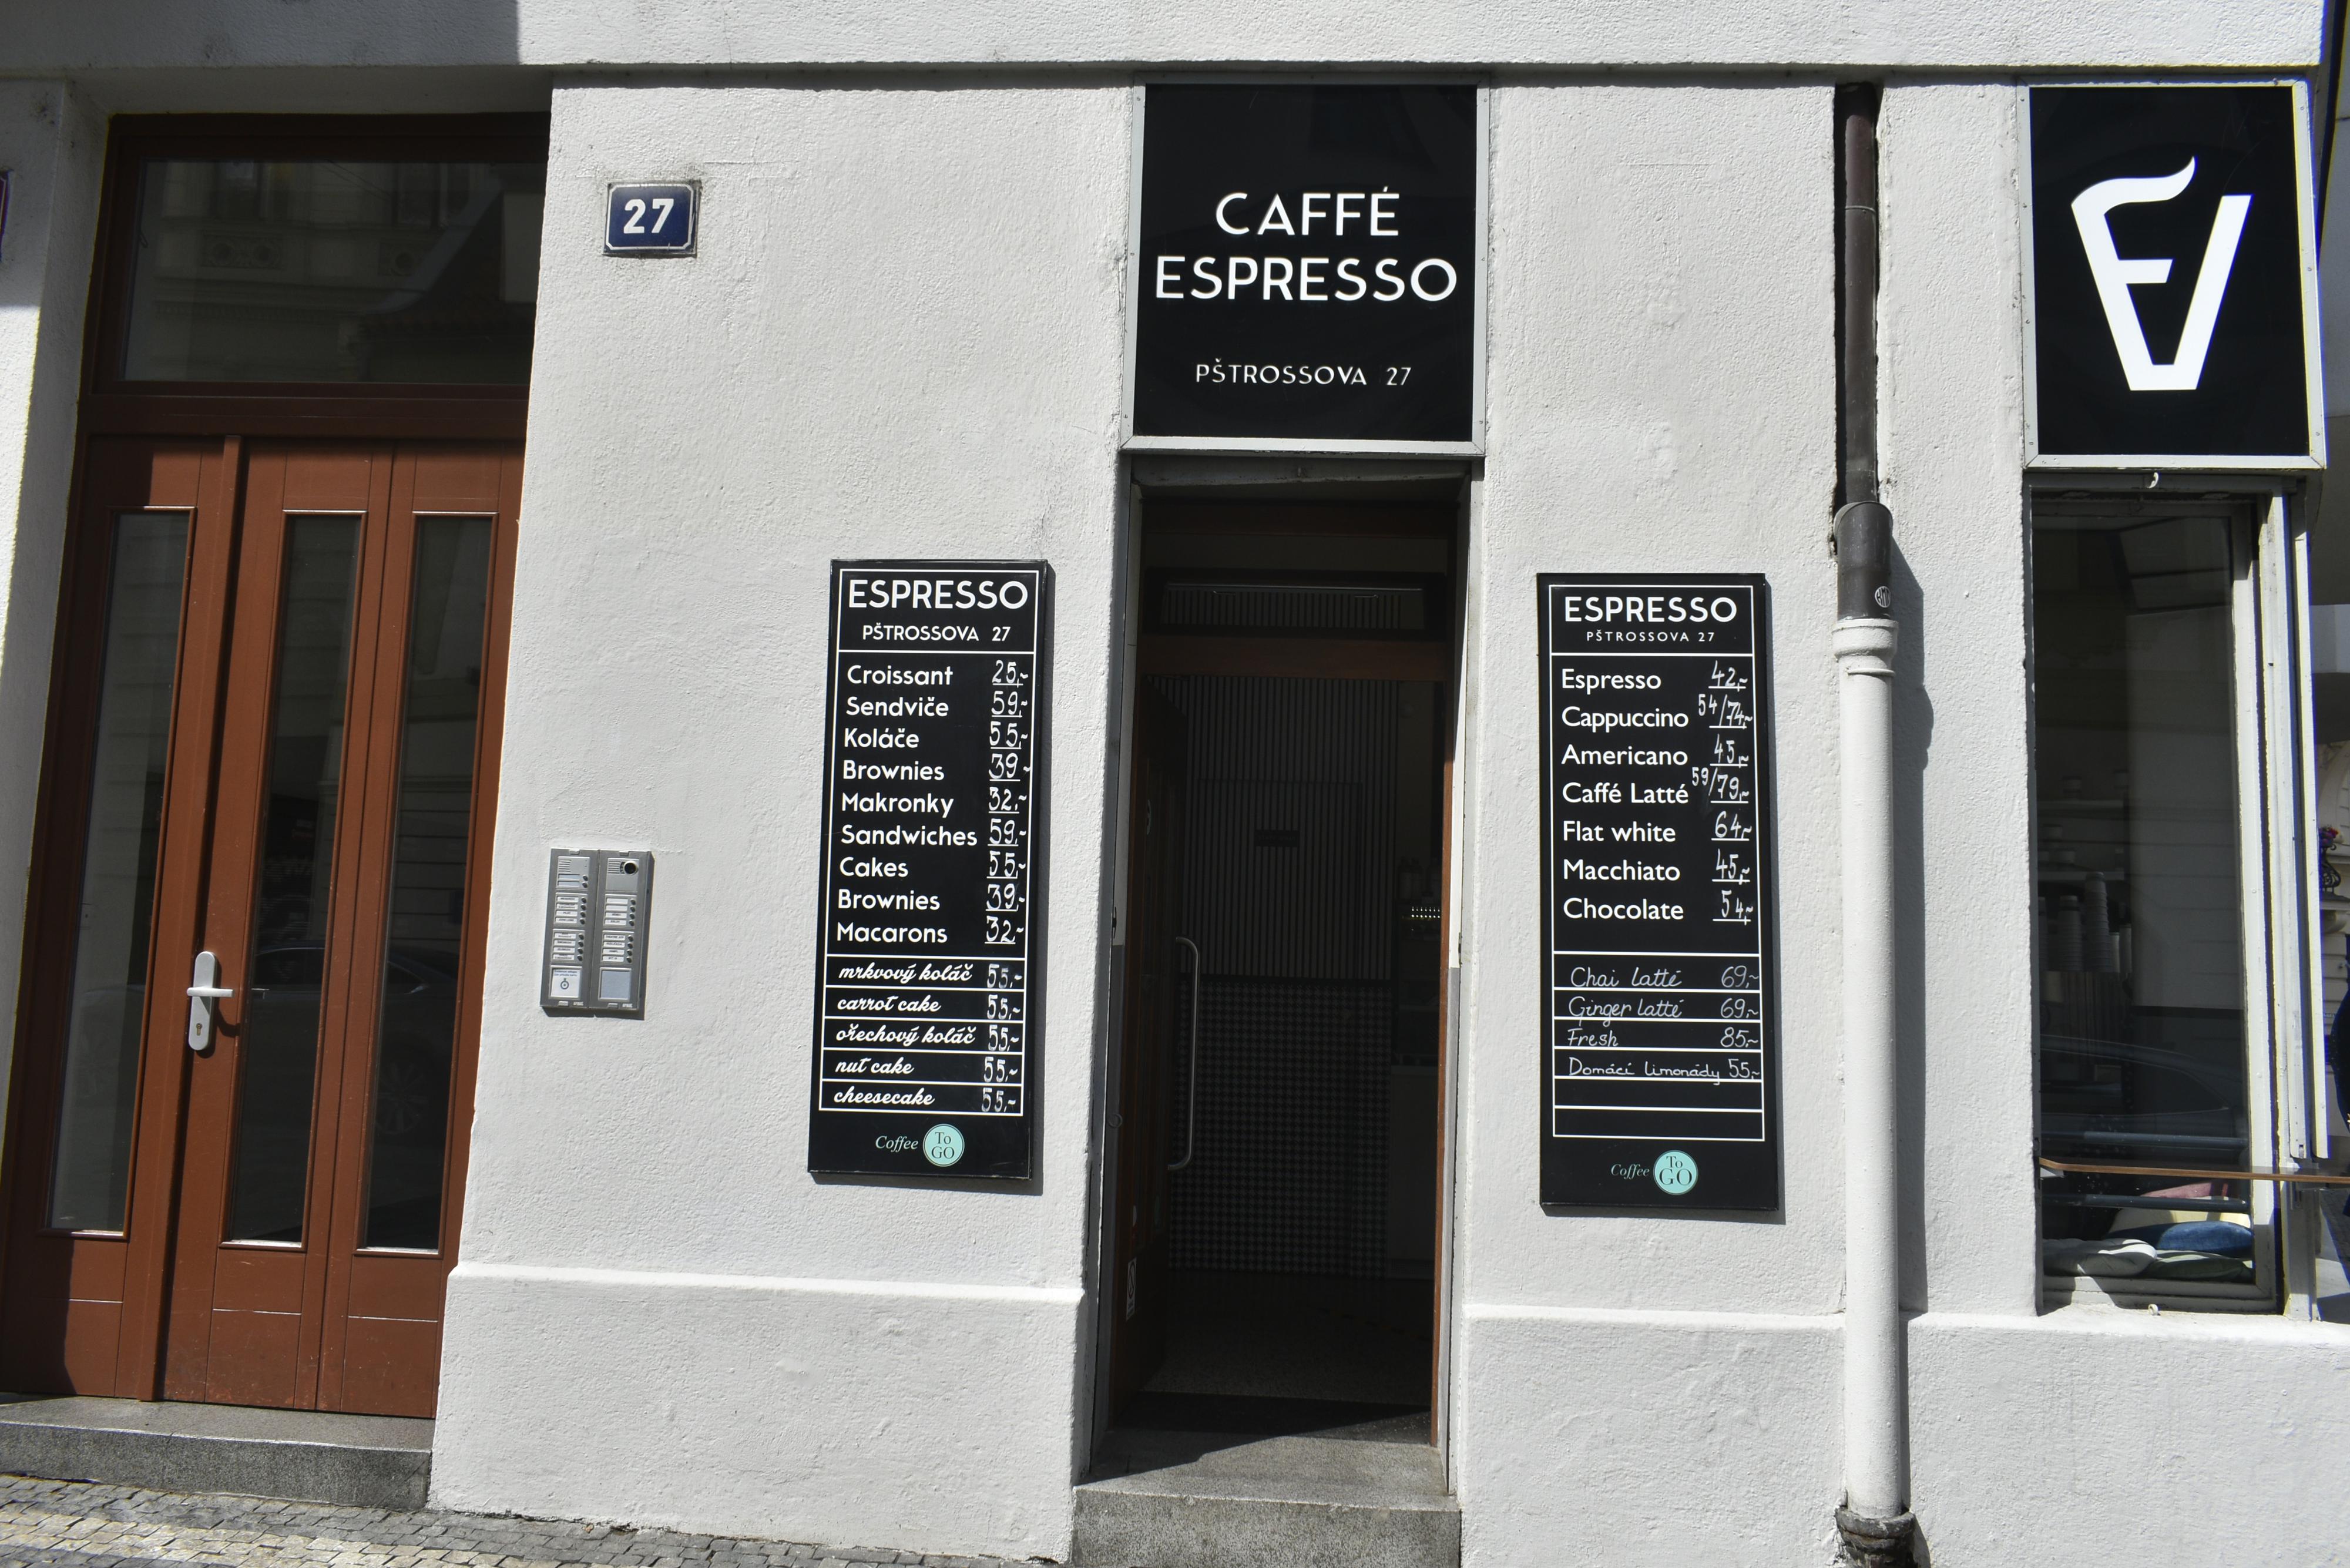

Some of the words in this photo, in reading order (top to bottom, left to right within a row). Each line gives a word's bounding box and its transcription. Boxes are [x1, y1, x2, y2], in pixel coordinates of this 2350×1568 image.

[623, 198, 674, 234] 27
[1216, 186, 1399, 236] CAFFÉ
[1156, 256, 1456, 301] ESPRESSO
[1197, 358, 1367, 385] PŠTROSSOVA
[1387, 367, 1411, 385] 27
[849, 580, 1028, 609] ESPRESSO
[1565, 597, 1737, 622] ESPRESSO
[863, 623, 979, 641] PŠTROSSOVA
[992, 626, 1010, 641] 27
[1587, 630, 1689, 642] PŠTROSSOVA
[1698, 632, 1714, 642] 27
[848, 665, 953, 685] Croissant
[1562, 669, 1661, 694] Espresso
[846, 697, 949, 716] Sendviče
[1562, 706, 1688, 733] Cappuccino
[845, 728, 919, 748] Koláče
[1562, 744, 1688, 765] Americano
[844, 760, 944, 780] Brownies
[1563, 783, 1622, 803] Caffé
[1631, 783, 1688, 804] Latté
[842, 793, 954, 818] Makronky
[841, 825, 977, 845] Sandwiches
[1564, 821, 1604, 841] Flat
[1611, 821, 1676, 842] white
[840, 857, 908, 877] Cakes
[1564, 859, 1680, 881] Macchiato
[838, 889, 940, 910] Brownies
[1564, 898, 1683, 919] Chocolate
[837, 922, 947, 943] Macarons
[839, 962, 916, 983] mrkvový
[919, 963, 973, 981] koláč
[1570, 966, 1619, 987] Chai
[837, 996, 898, 1010] carrot
[898, 995, 941, 1012] cake
[1569, 996, 1631, 1027] Ginger
[836, 1023, 919, 1046] ořechový
[921, 1026, 976, 1044] koláč
[1567, 1028, 1618, 1046] Fresh
[835, 1057, 871, 1073] nut
[871, 1057, 914, 1074] cake
[834, 1086, 935, 1105] cheesecake
[875, 1135, 919, 1153] Coffee
[935, 1131, 951, 1144] To
[931, 1146, 955, 1159] GO
[1666, 1155, 1683, 1169] To
[1610, 1163, 1650, 1180] Coffee
[1659, 1168, 1693, 1186] GO
